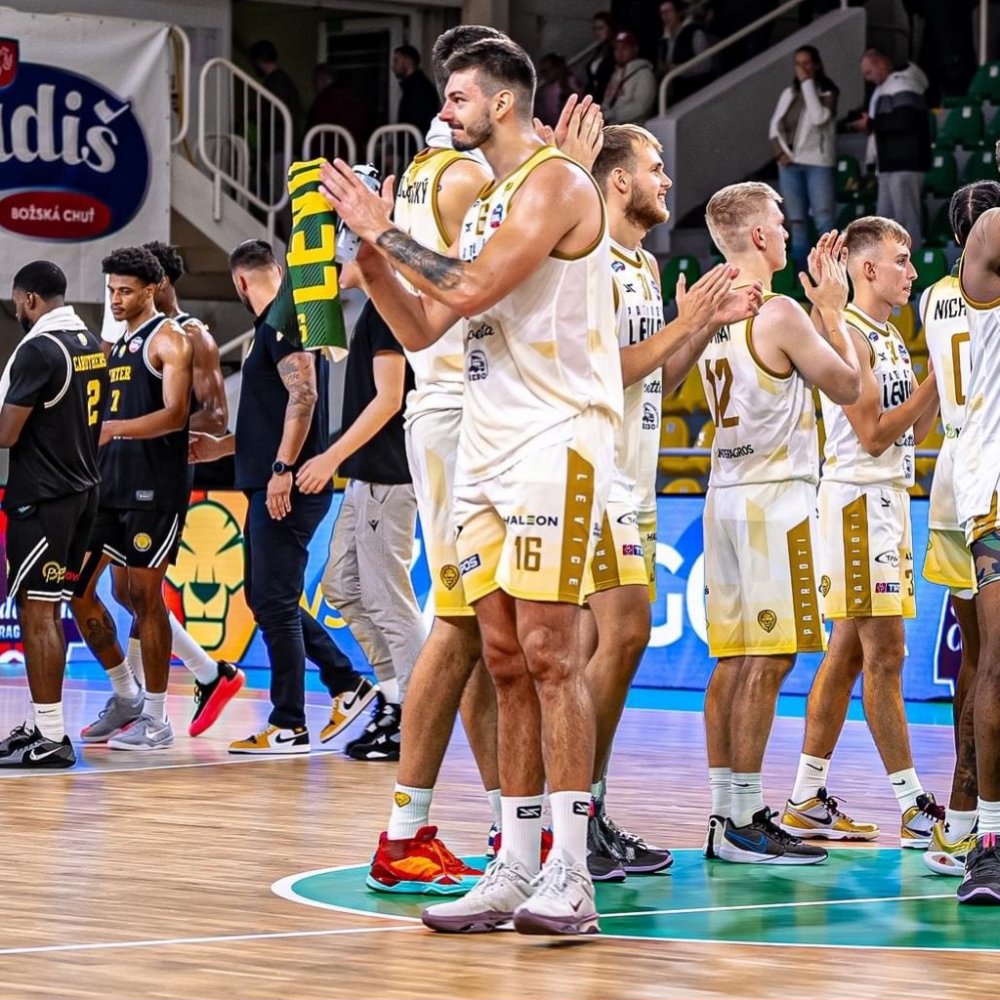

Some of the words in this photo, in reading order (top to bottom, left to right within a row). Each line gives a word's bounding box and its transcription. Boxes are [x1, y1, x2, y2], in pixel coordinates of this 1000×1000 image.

[11, 204, 60, 221] BOŽSKÁ
[63, 207, 95, 223] CHUŤ
[934, 297, 967, 320] NICH
[87, 379, 100, 427] 2
[705, 357, 740, 428] 12
[514, 535, 542, 572] 16
